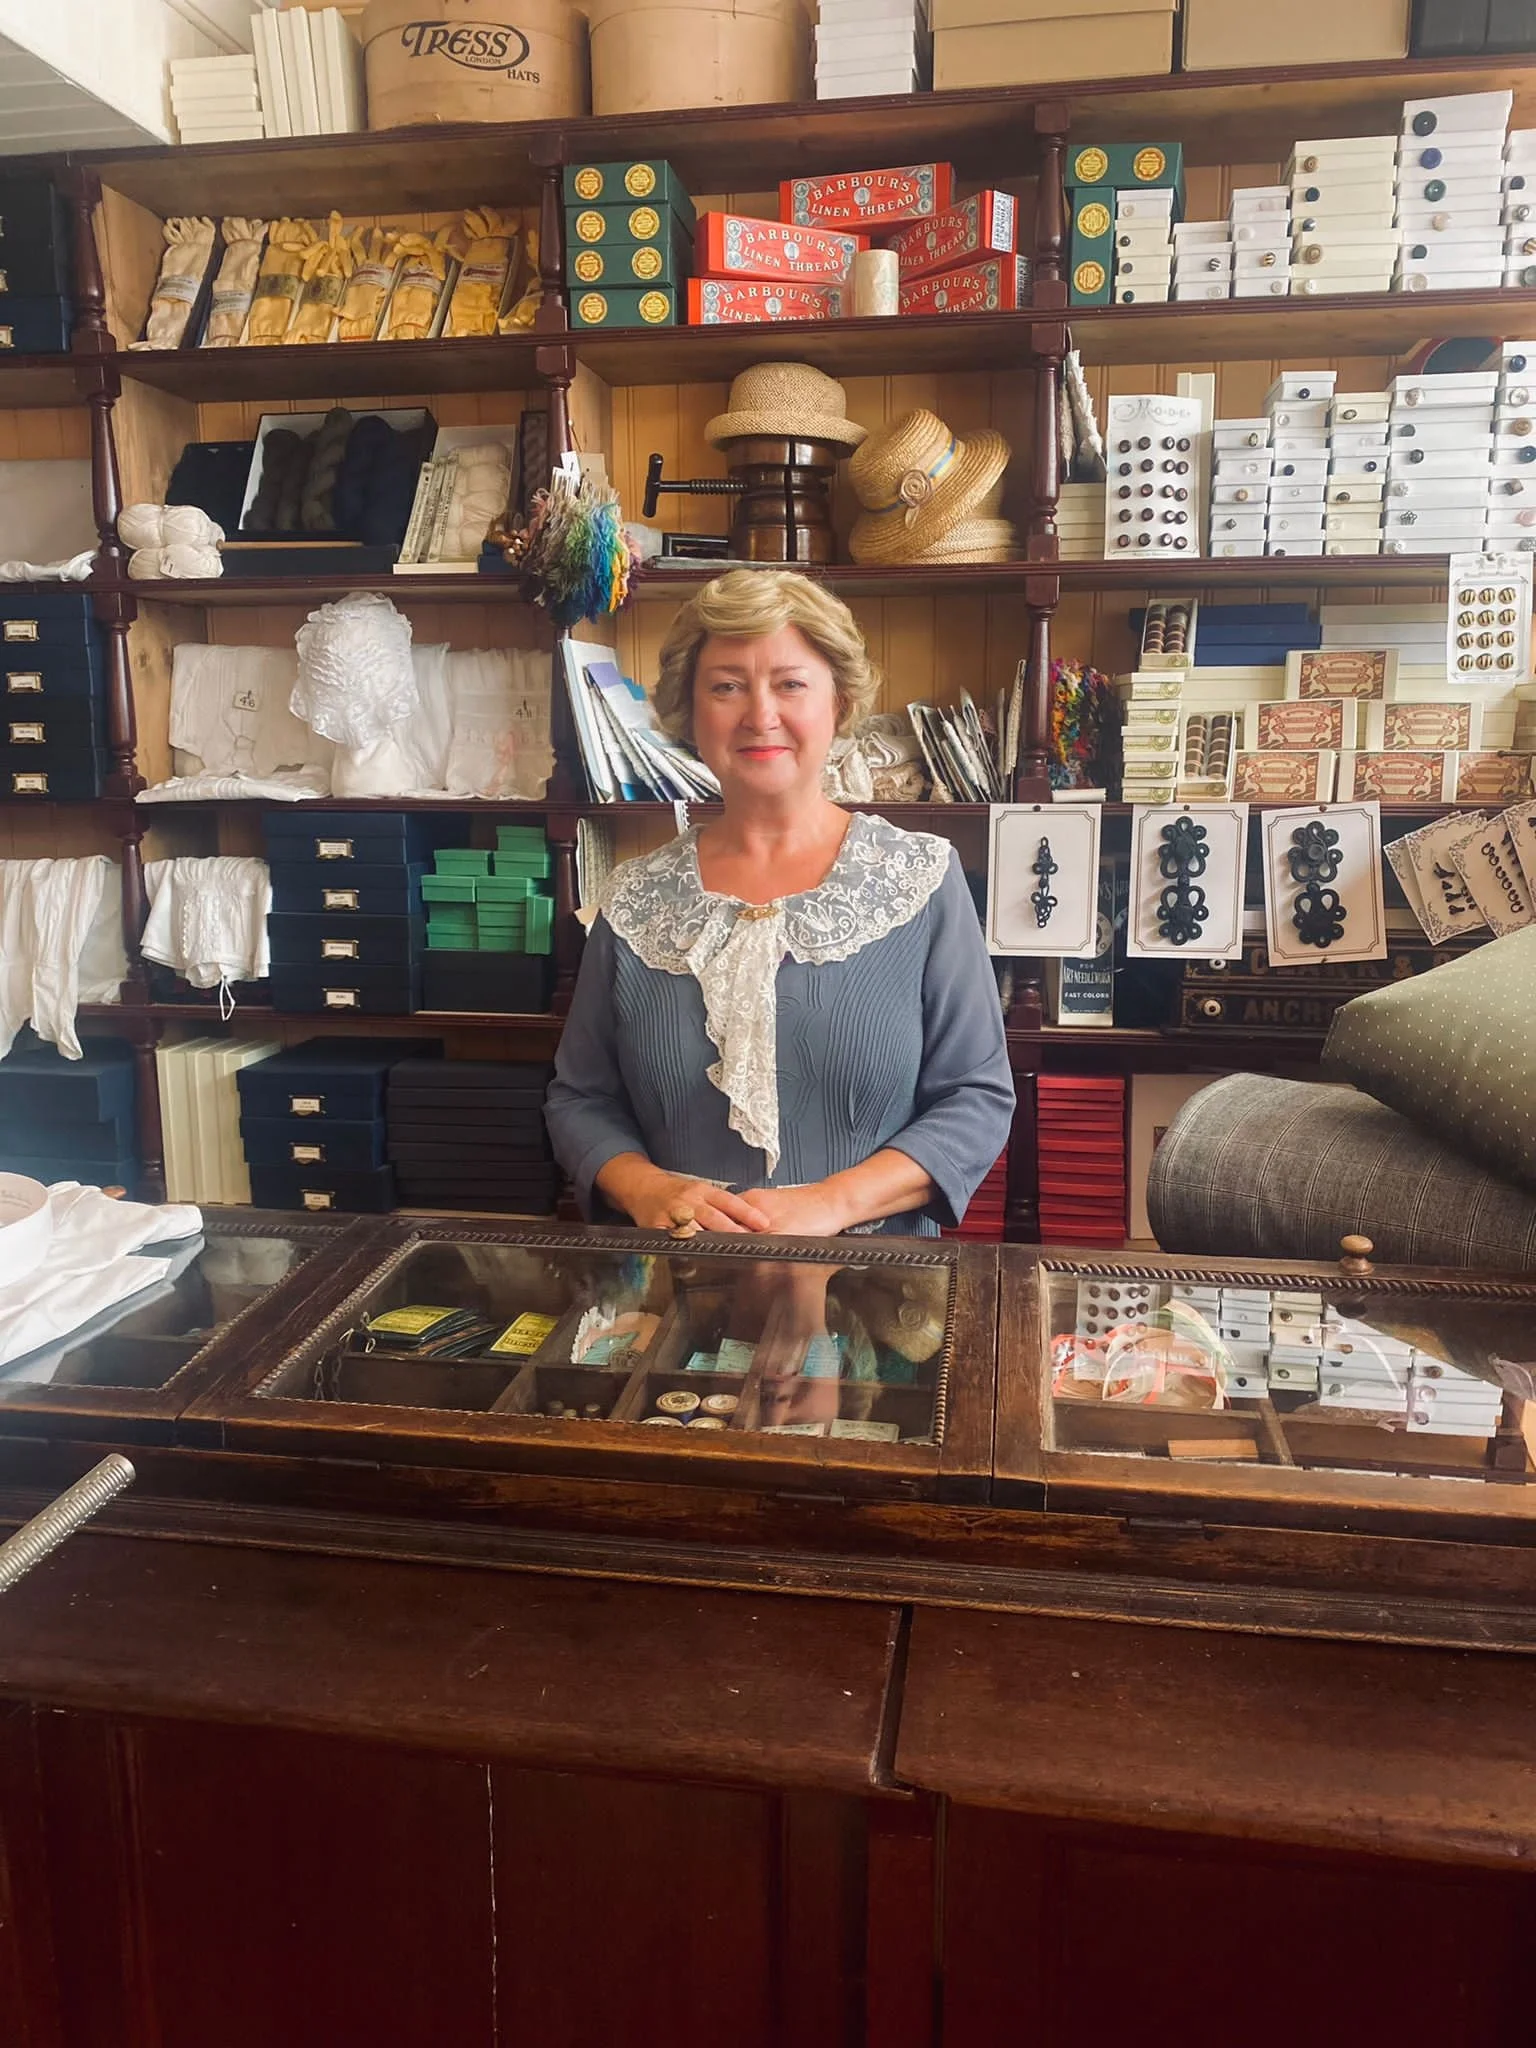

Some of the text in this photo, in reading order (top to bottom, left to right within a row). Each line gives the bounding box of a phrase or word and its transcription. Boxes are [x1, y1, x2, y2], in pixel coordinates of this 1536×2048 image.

[401, 20, 512, 58] TRESS
[465, 55, 502, 65] LONDON
[507, 69, 541, 84] HATS
[812, 175, 911, 201] BARBOUR'S
[811, 193, 914, 217] LINEN THREAD
[745, 229, 836, 257] BARBOUR'S
[929, 229, 965, 261] THREAD
[744, 246, 839, 272] LINEN THREAD
[723, 287, 822, 309] BARBOUR'S
[902, 276, 981, 309] BARBOUR'S
[938, 291, 983, 313] HREAD
[721, 306, 761, 322] LINEN
